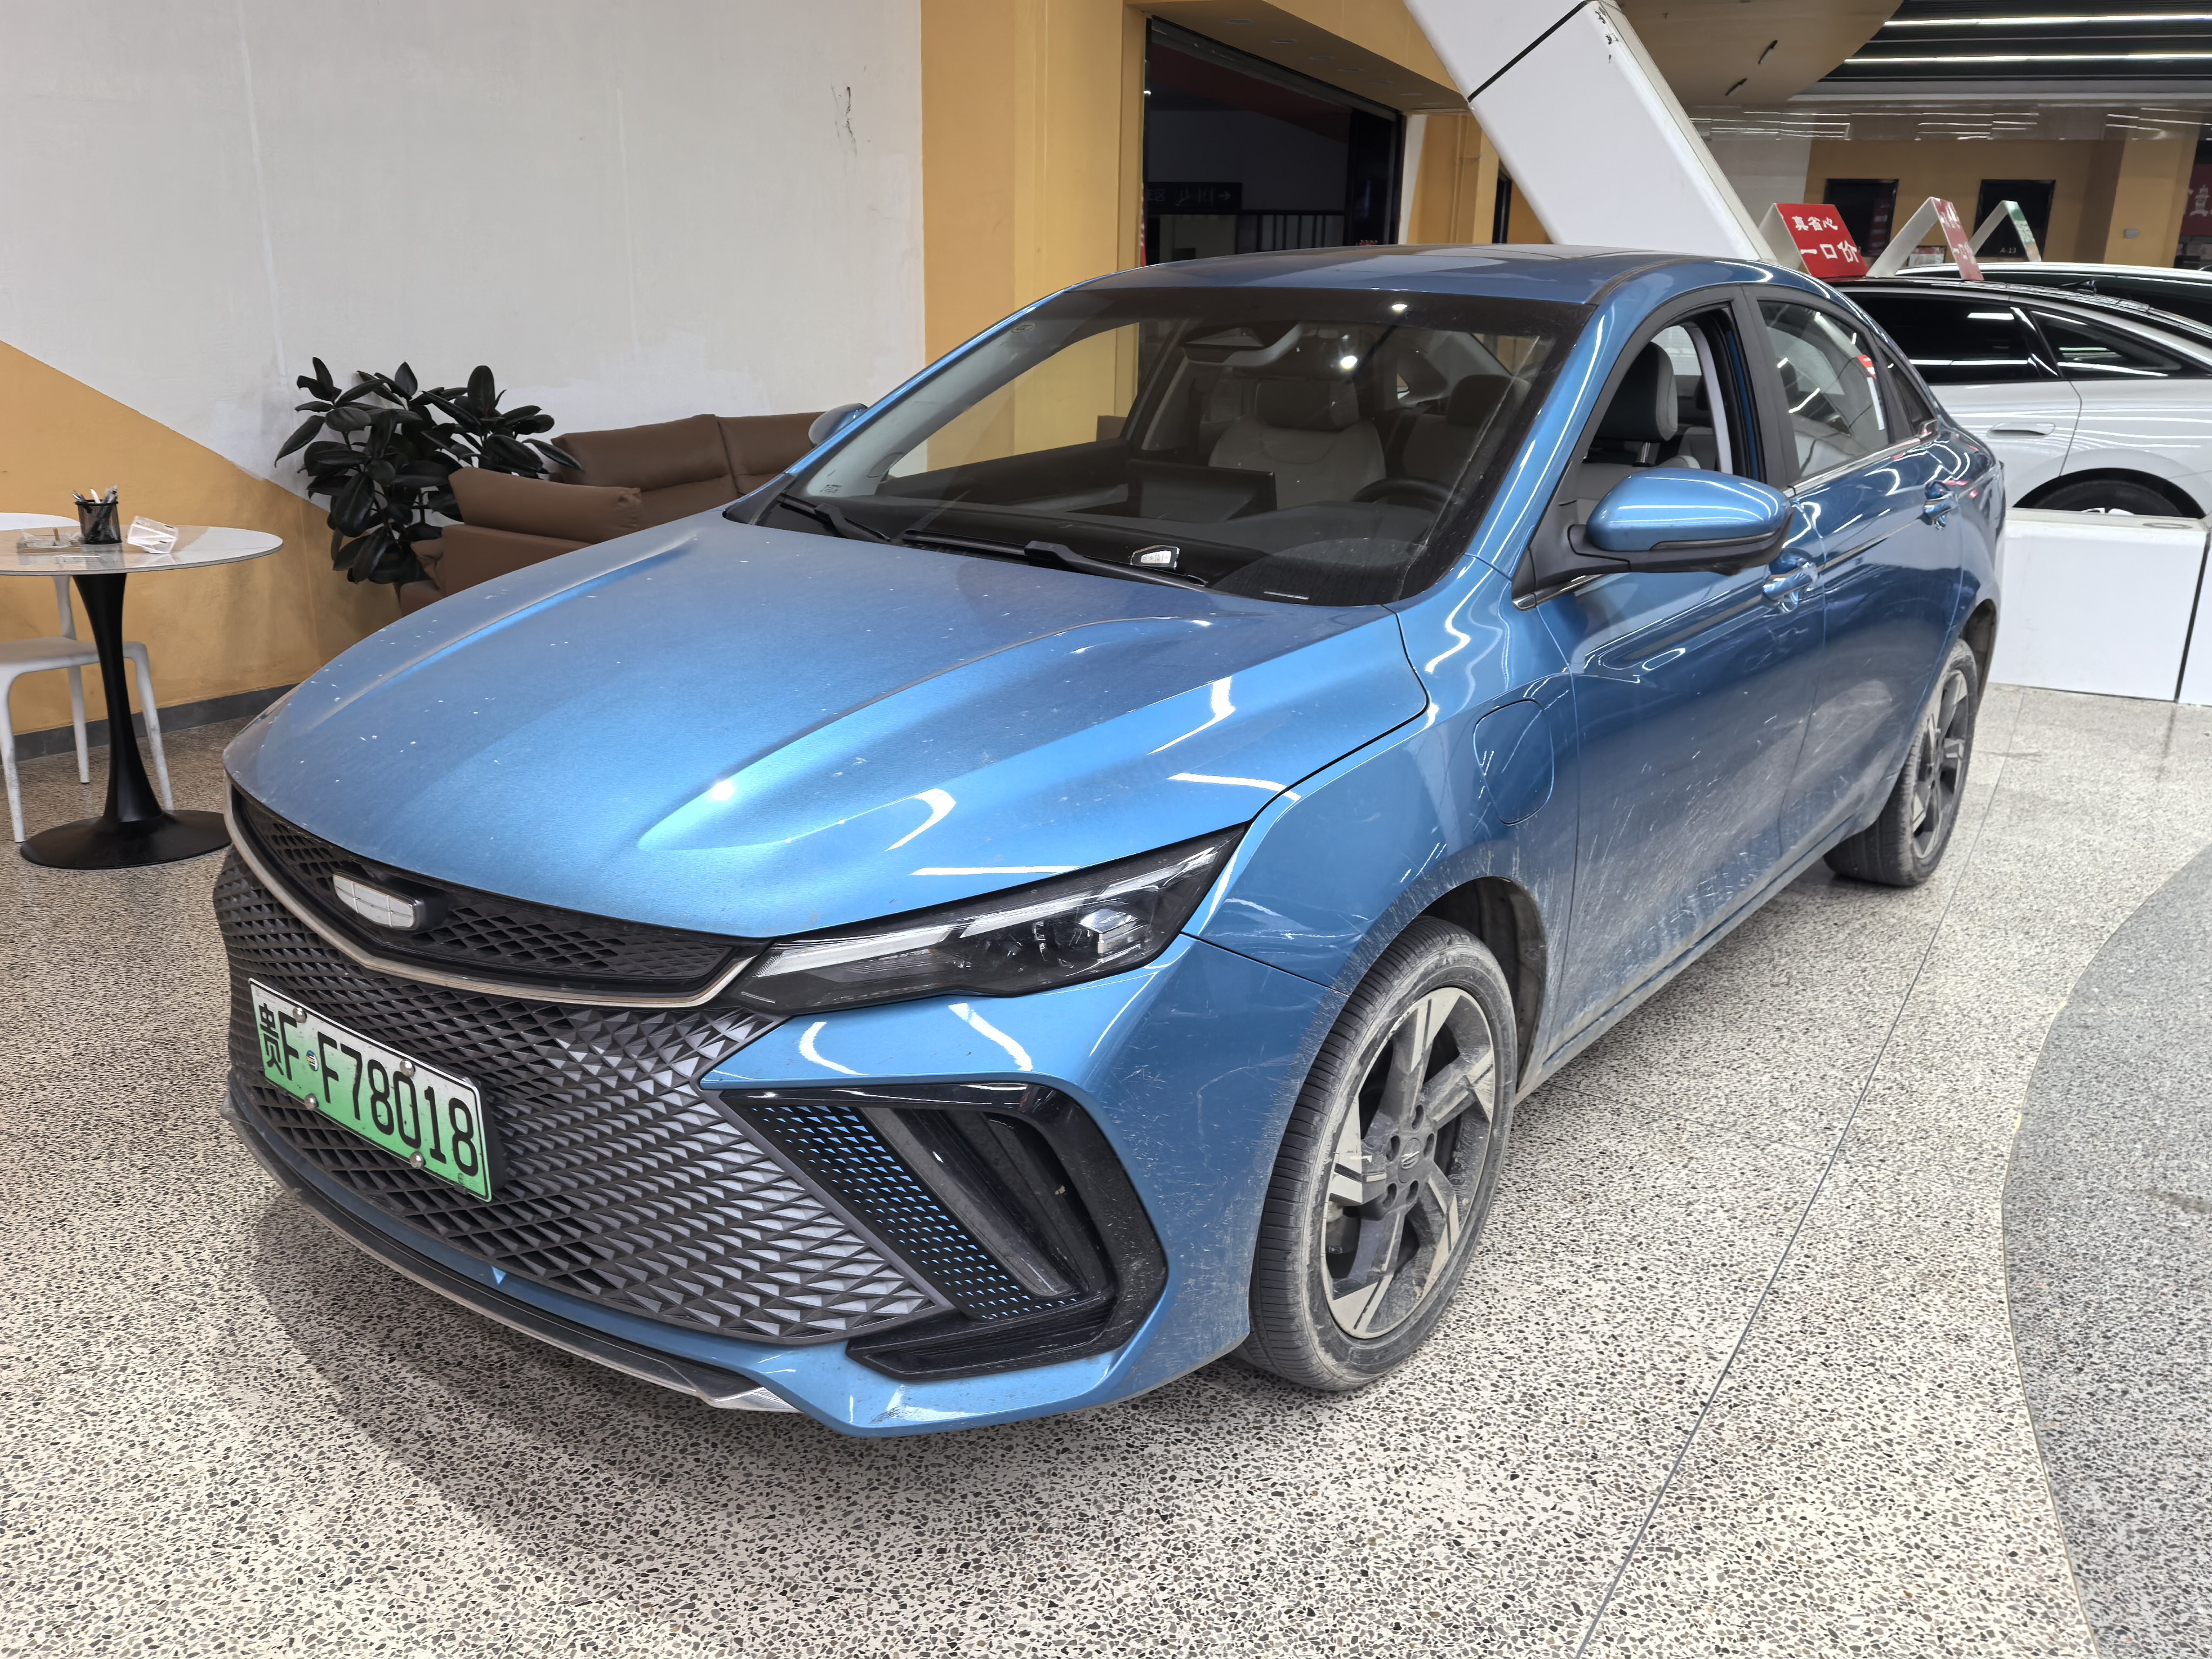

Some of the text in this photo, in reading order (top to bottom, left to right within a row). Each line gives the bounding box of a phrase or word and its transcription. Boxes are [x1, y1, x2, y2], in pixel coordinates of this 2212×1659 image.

[1791, 215, 1838, 231] 真省心
[1800, 240, 1859, 263] 一口价
